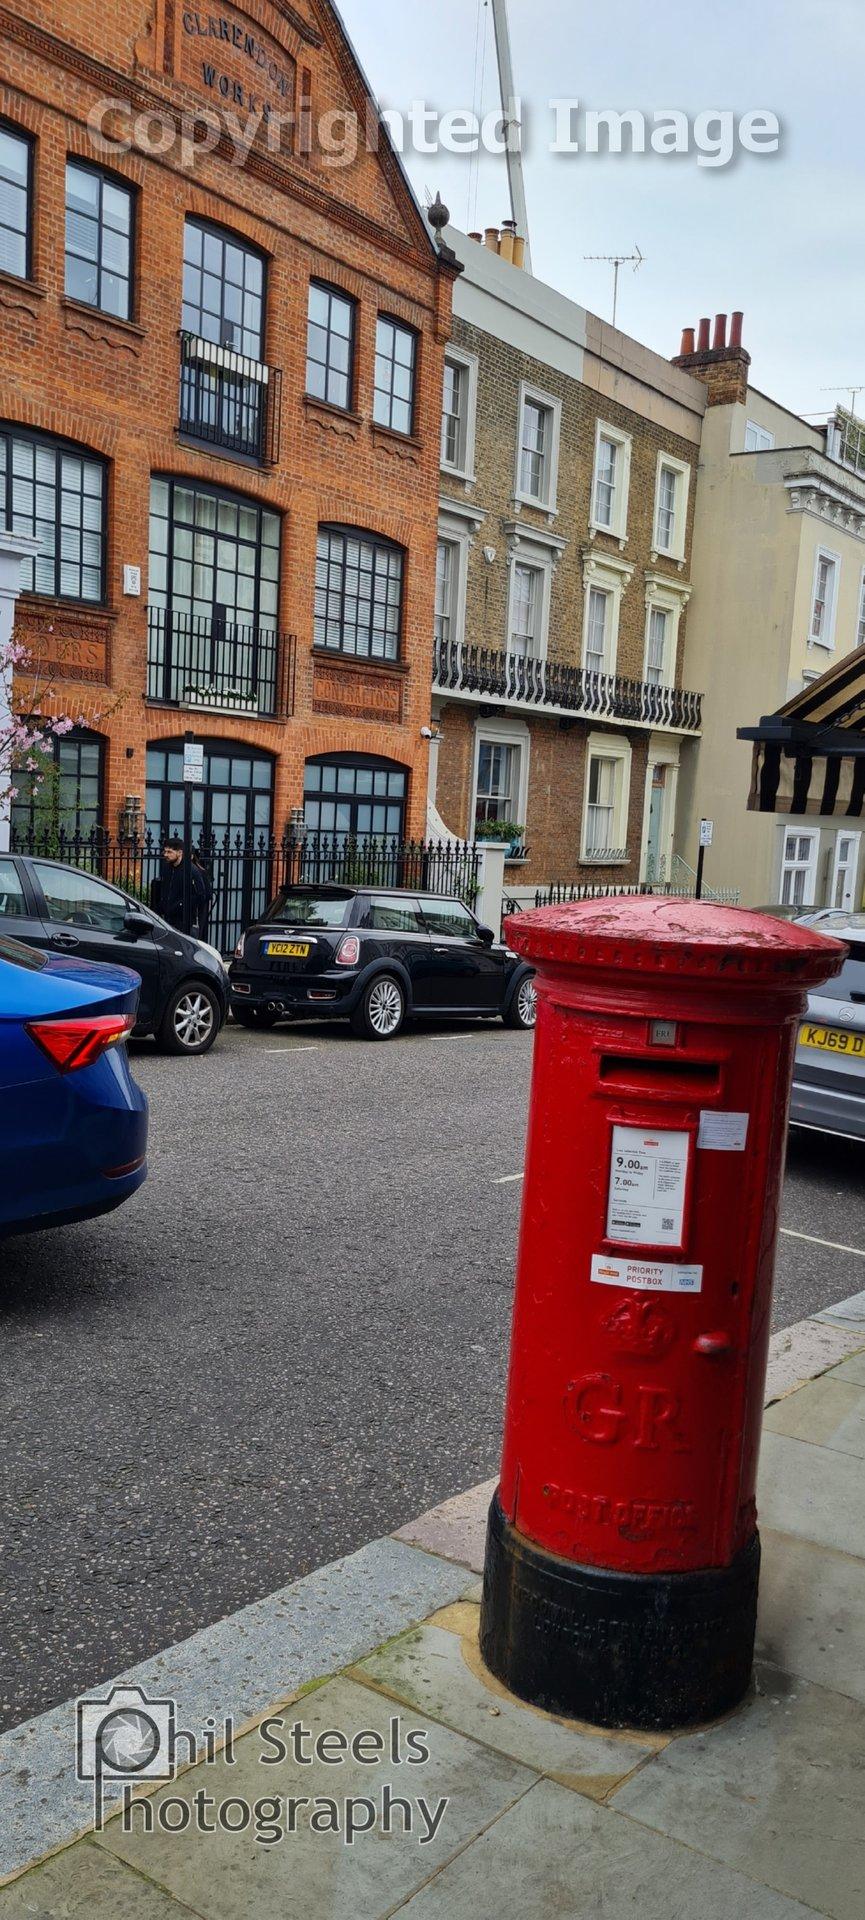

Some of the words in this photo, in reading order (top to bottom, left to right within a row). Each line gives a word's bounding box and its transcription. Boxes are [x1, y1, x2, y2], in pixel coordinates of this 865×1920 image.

[183, 12, 289, 97] CLARENDON
[202, 62, 271, 123] WORKS
[315, 680, 398, 709] CONTRACTORS
[271, 944, 288, 953] YC12
[289, 945, 307, 954] ZTN
[807, 1028, 848, 1050] KJ69
[852, 1037, 864, 1052] D
[626, 1275, 663, 1285] POSTBOX
[627, 1265, 664, 1275] PRIORITY
[562, 1373, 692, 1454] GR
